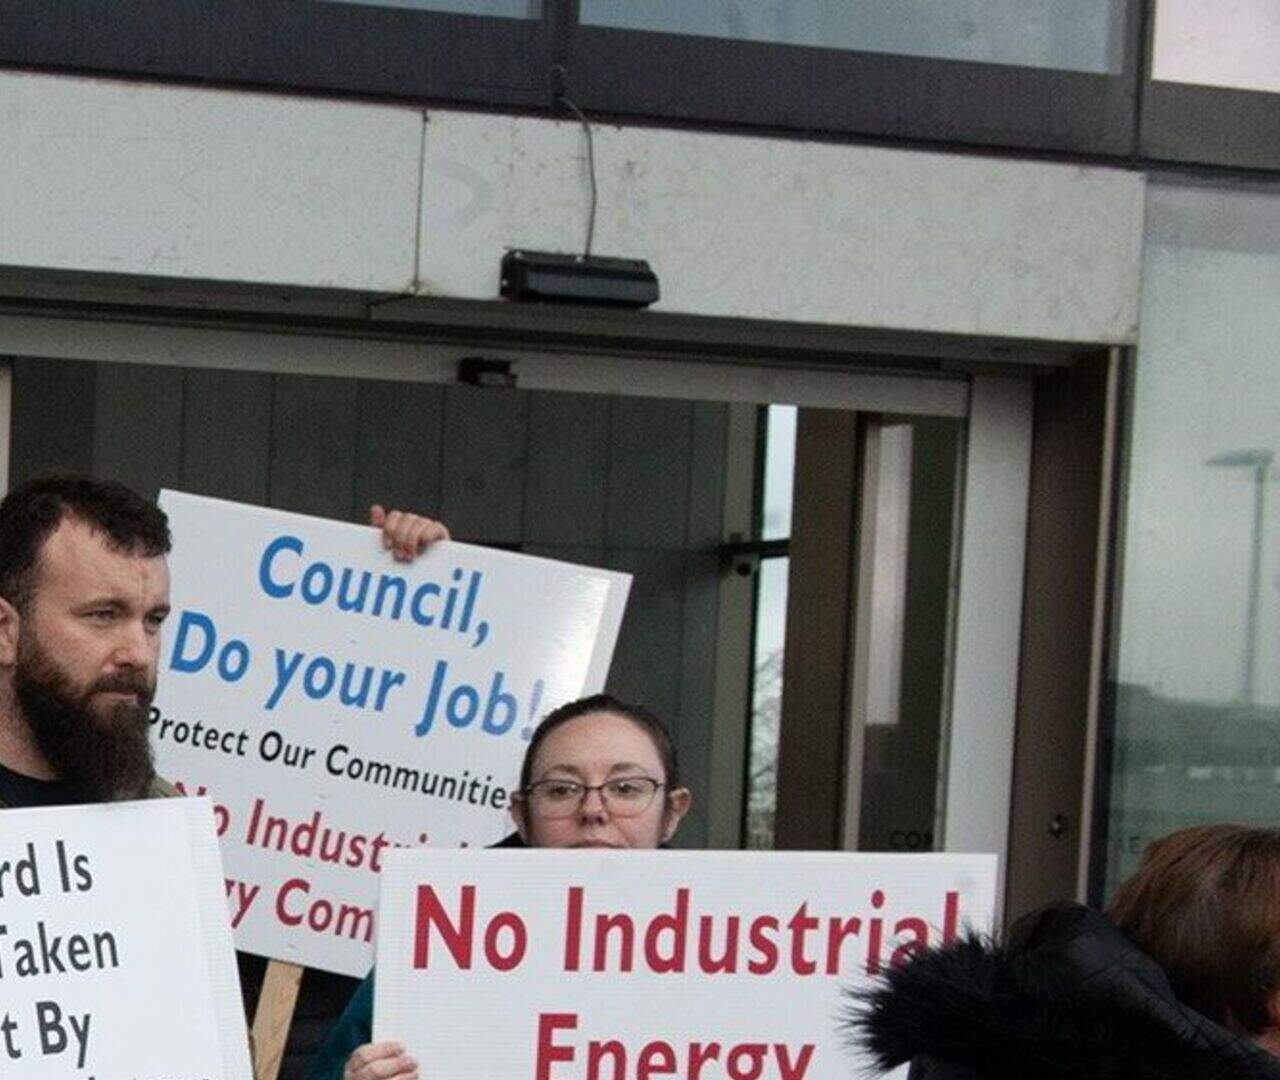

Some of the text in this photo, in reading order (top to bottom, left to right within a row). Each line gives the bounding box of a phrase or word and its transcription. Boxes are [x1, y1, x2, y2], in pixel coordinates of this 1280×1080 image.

[259, 535, 490, 648] Council,
[170, 611, 544, 741] Do your Job!
[259, 731, 317, 769] Our
[326, 744, 513, 811] Communitie
[56, 839, 93, 893] Is
[413, 885, 959, 976] No Industrial
[36, 1000, 91, 1069] By
